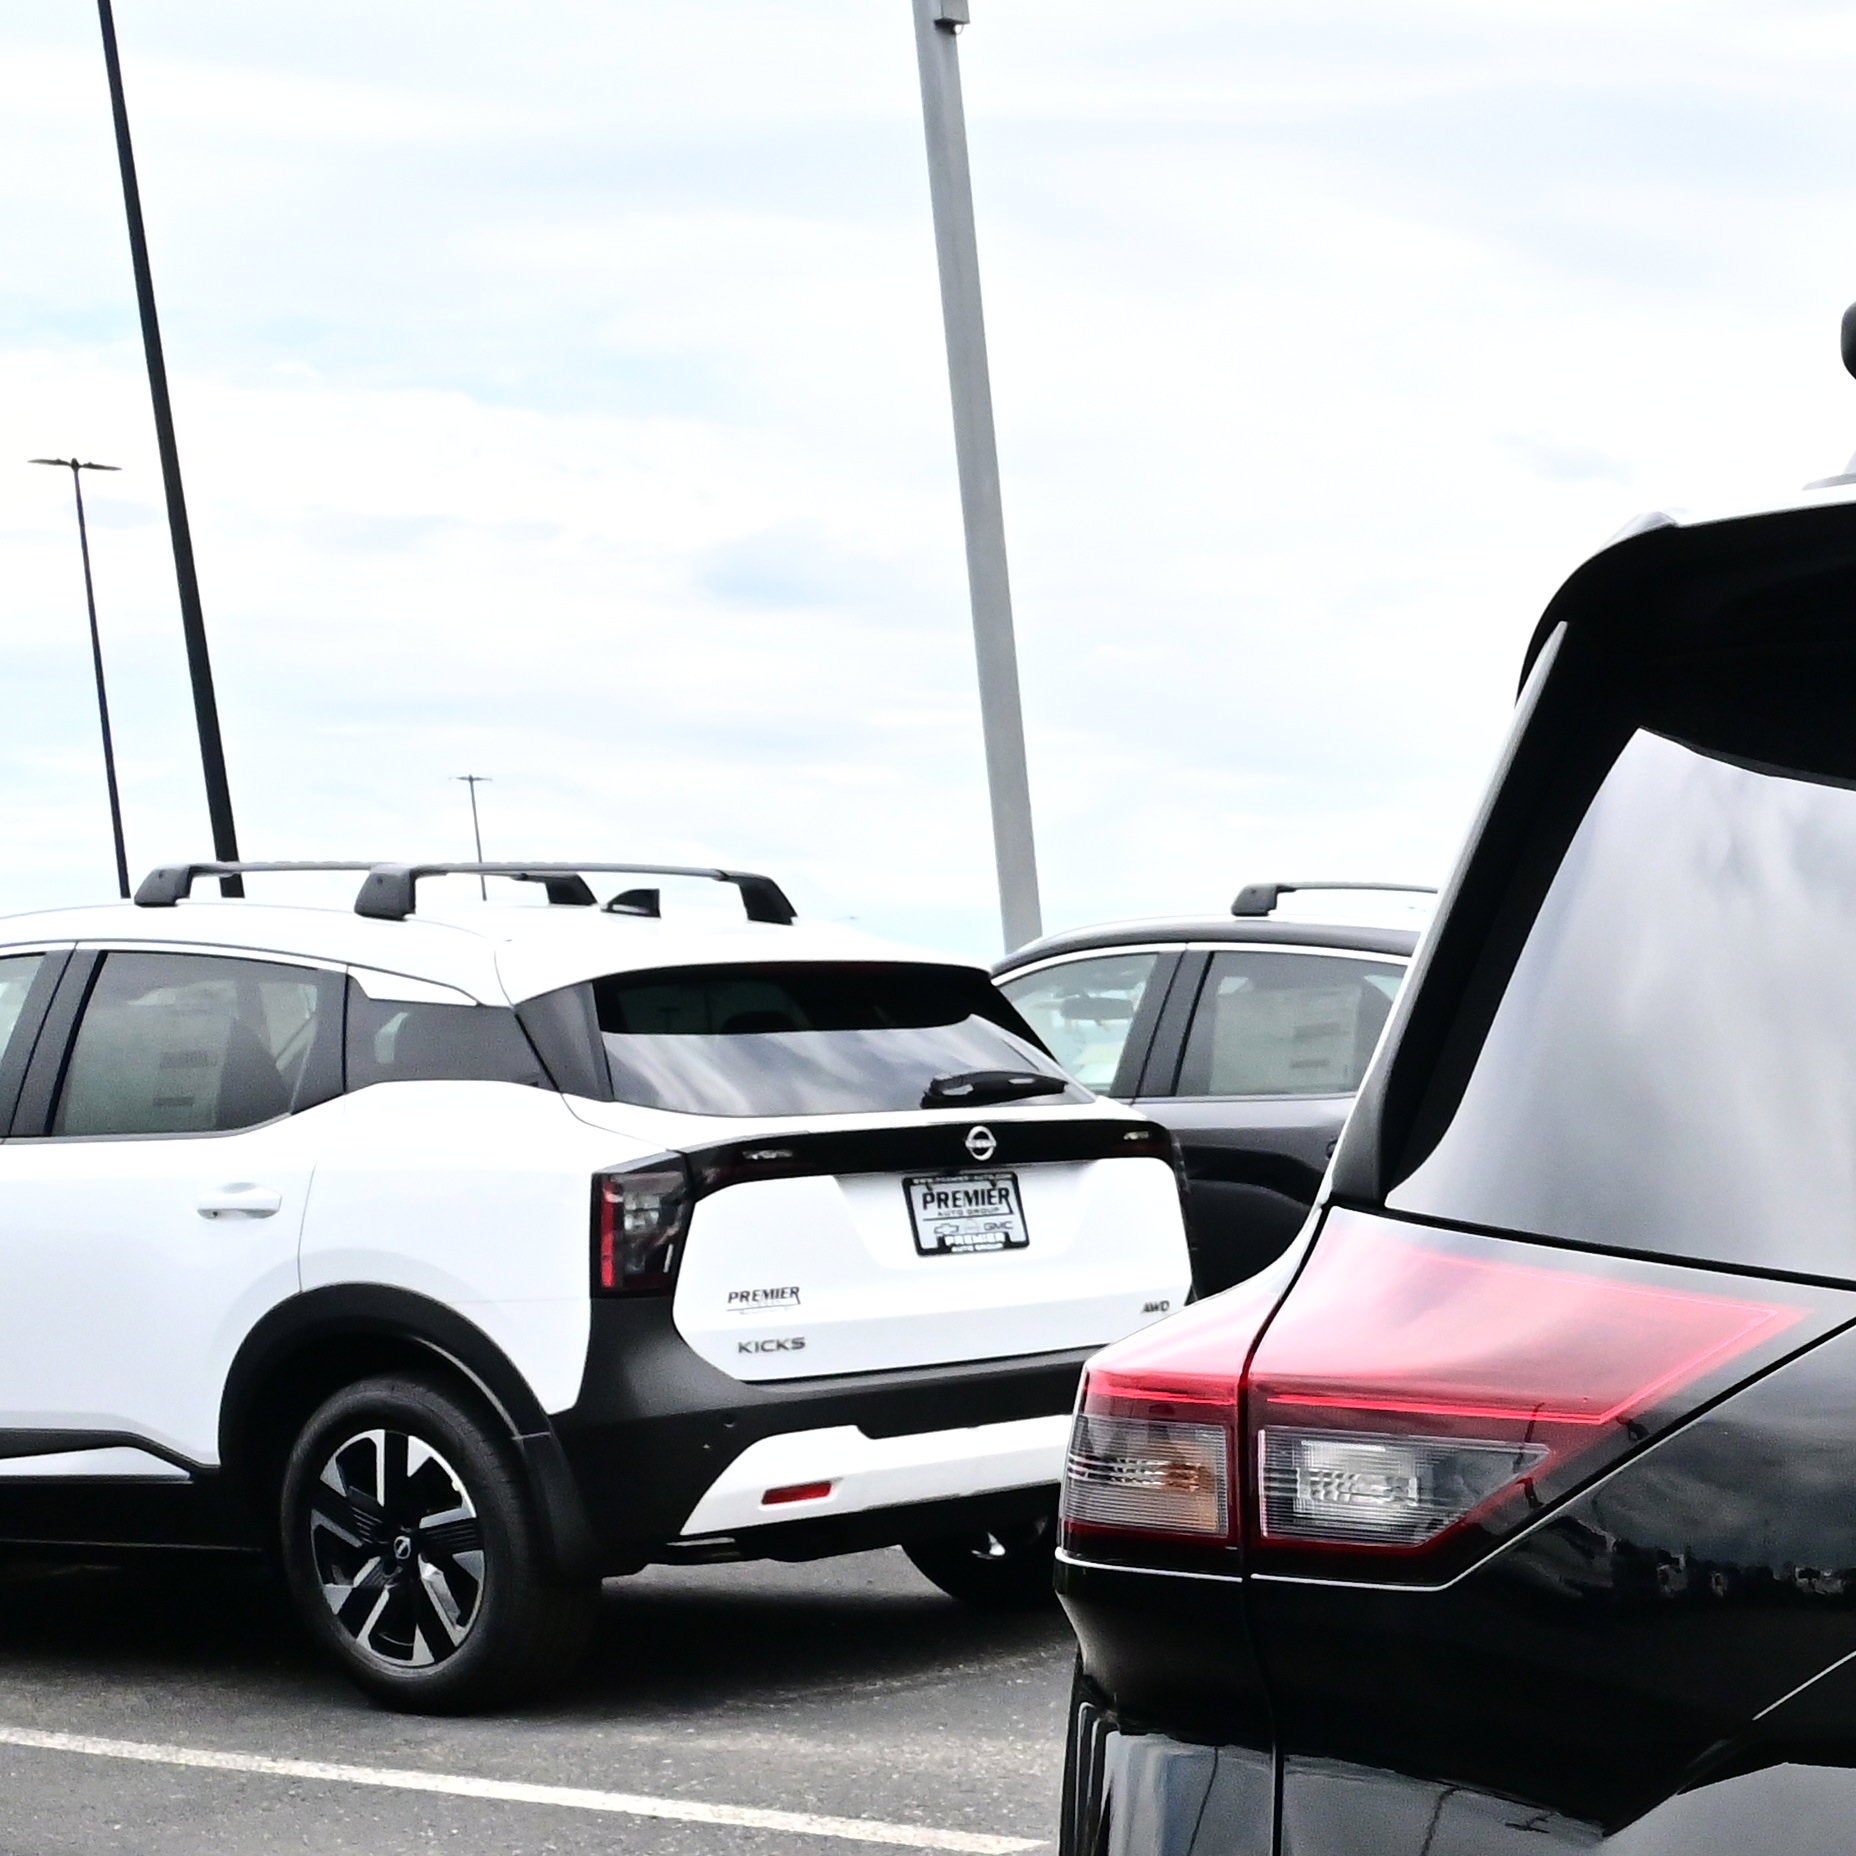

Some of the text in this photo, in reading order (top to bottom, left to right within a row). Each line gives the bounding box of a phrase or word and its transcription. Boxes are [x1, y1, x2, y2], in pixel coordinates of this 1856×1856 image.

[922, 1187, 1012, 1213] PREMIER
[727, 1286, 801, 1304] PREMIER
[738, 1336, 806, 1353] KICKS
